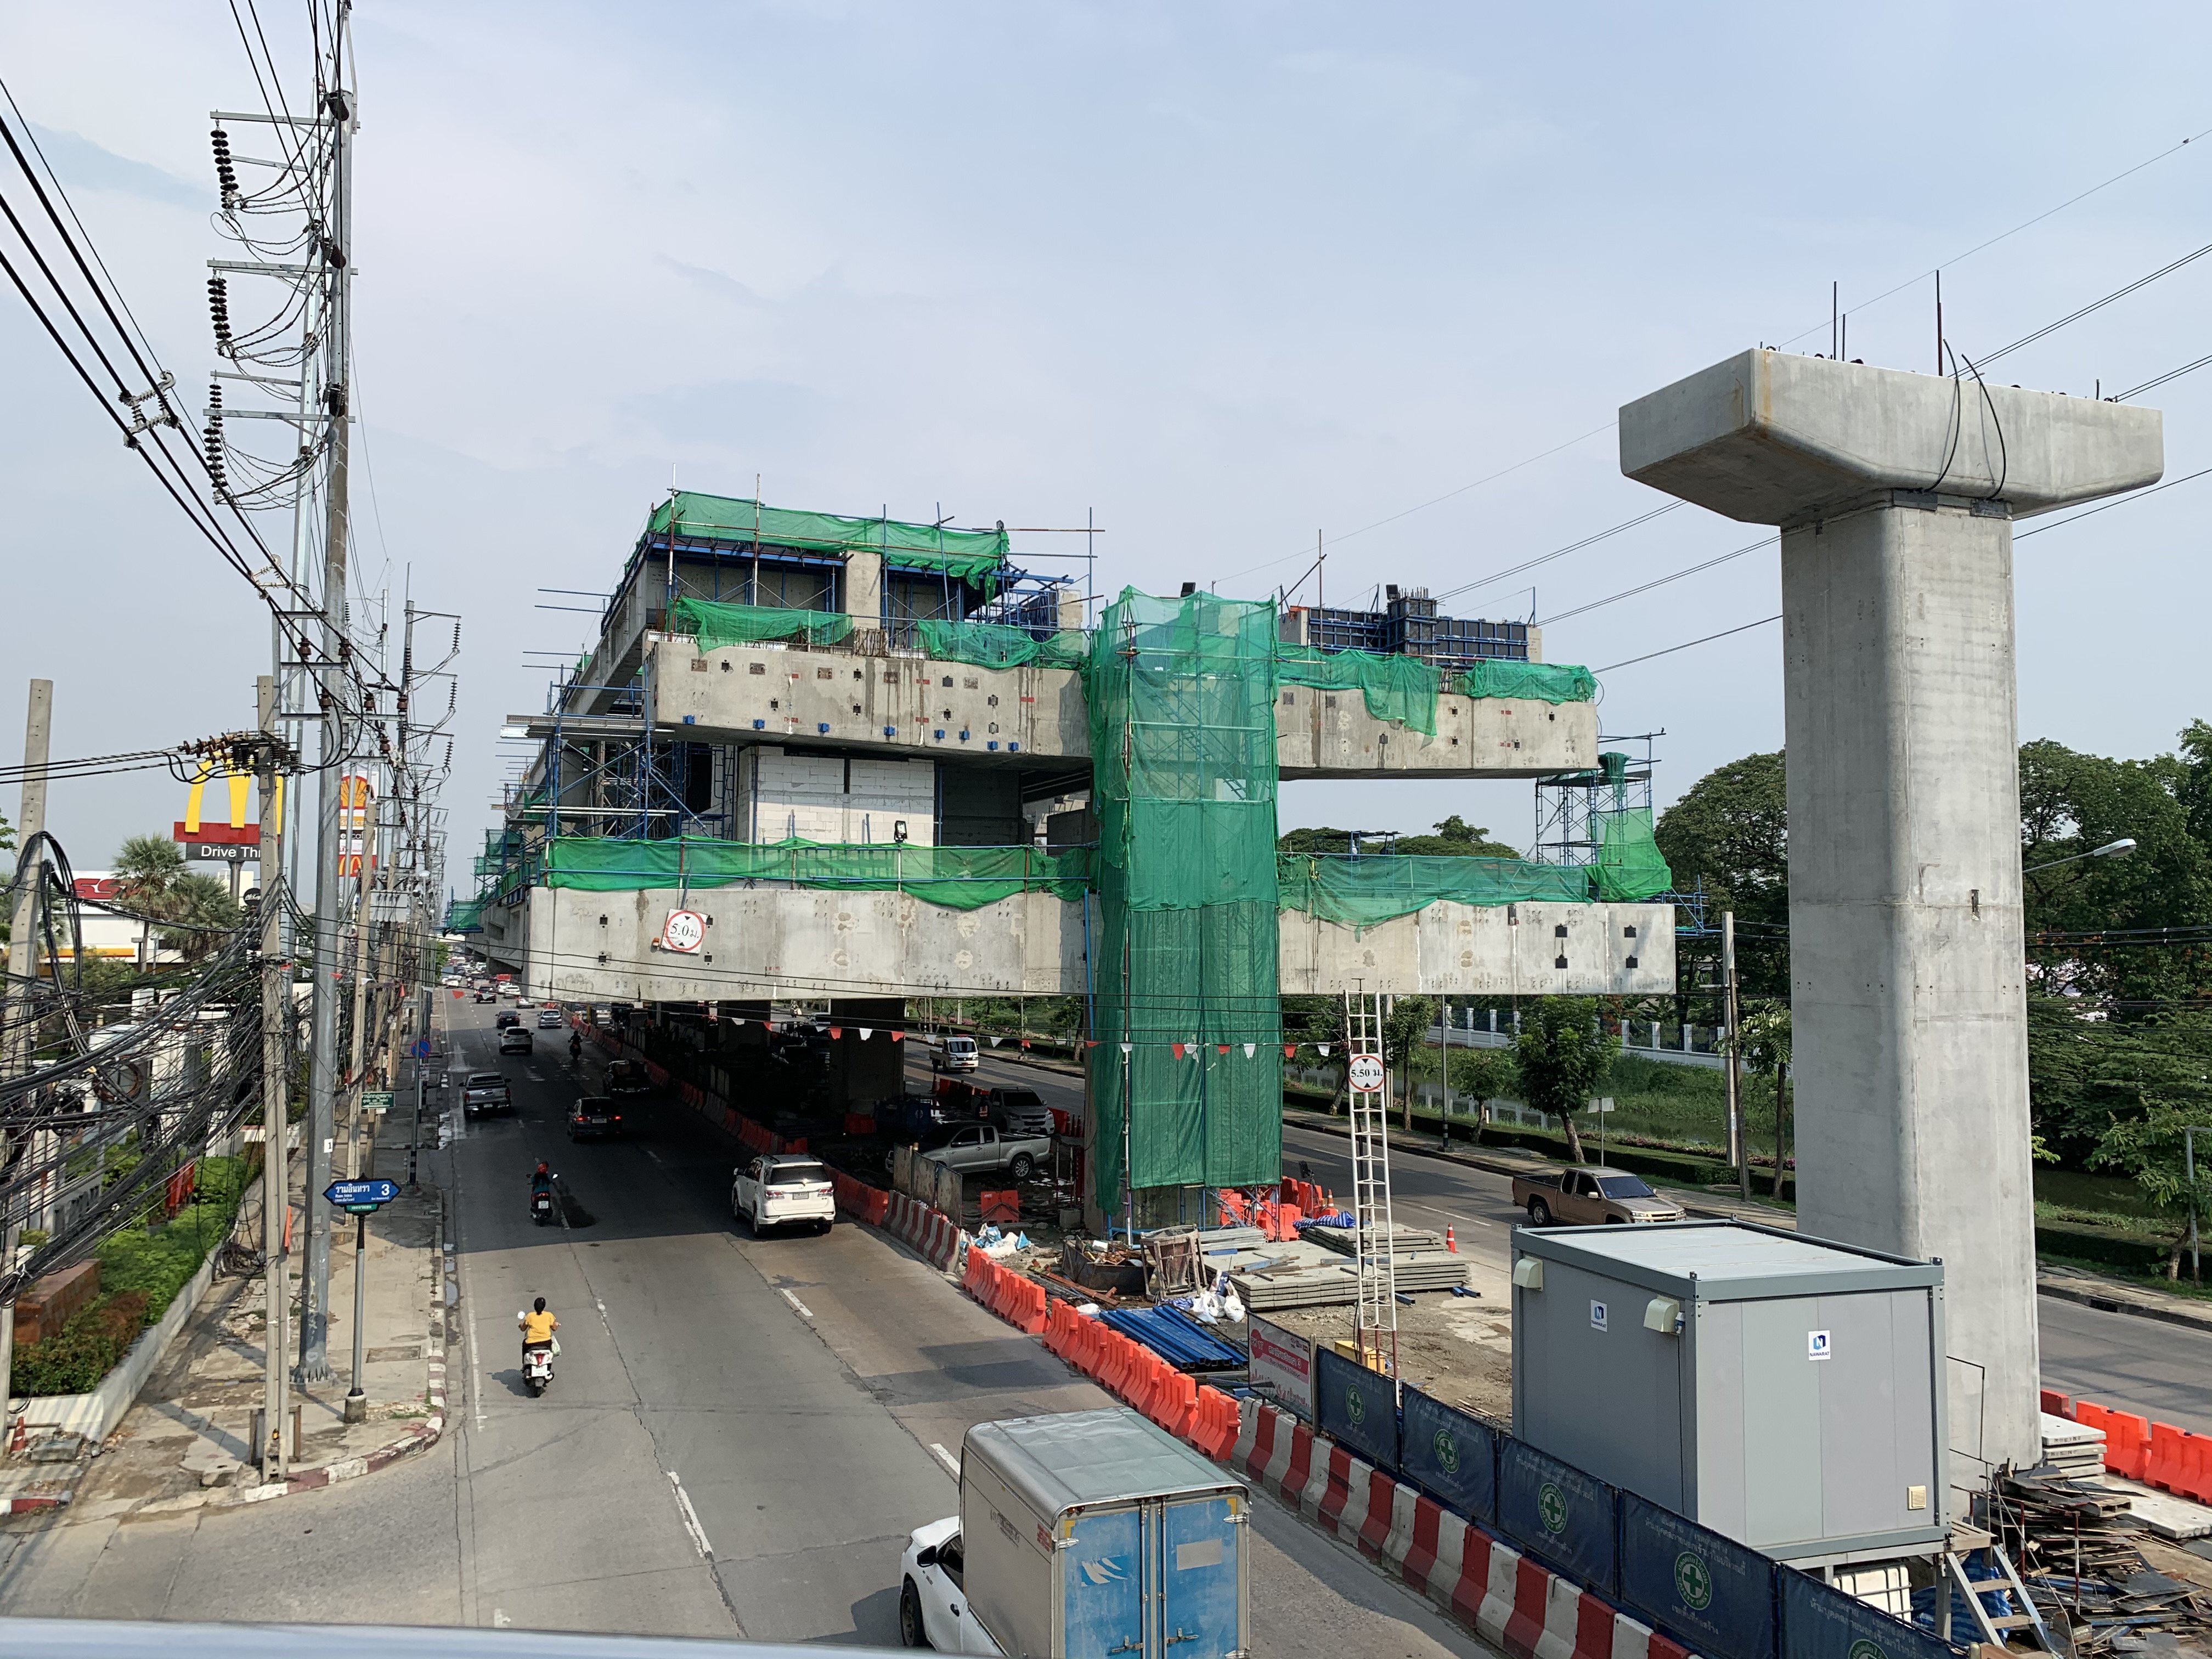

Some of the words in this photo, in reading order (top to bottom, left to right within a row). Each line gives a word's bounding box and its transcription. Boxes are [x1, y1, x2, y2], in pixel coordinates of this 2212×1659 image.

[201, 845, 236, 857] Drive
[1351, 1069, 1370, 1077] 5.50
[335, 1183, 370, 1193] รามอินทรา
[381, 1184, 390, 1196] 3
